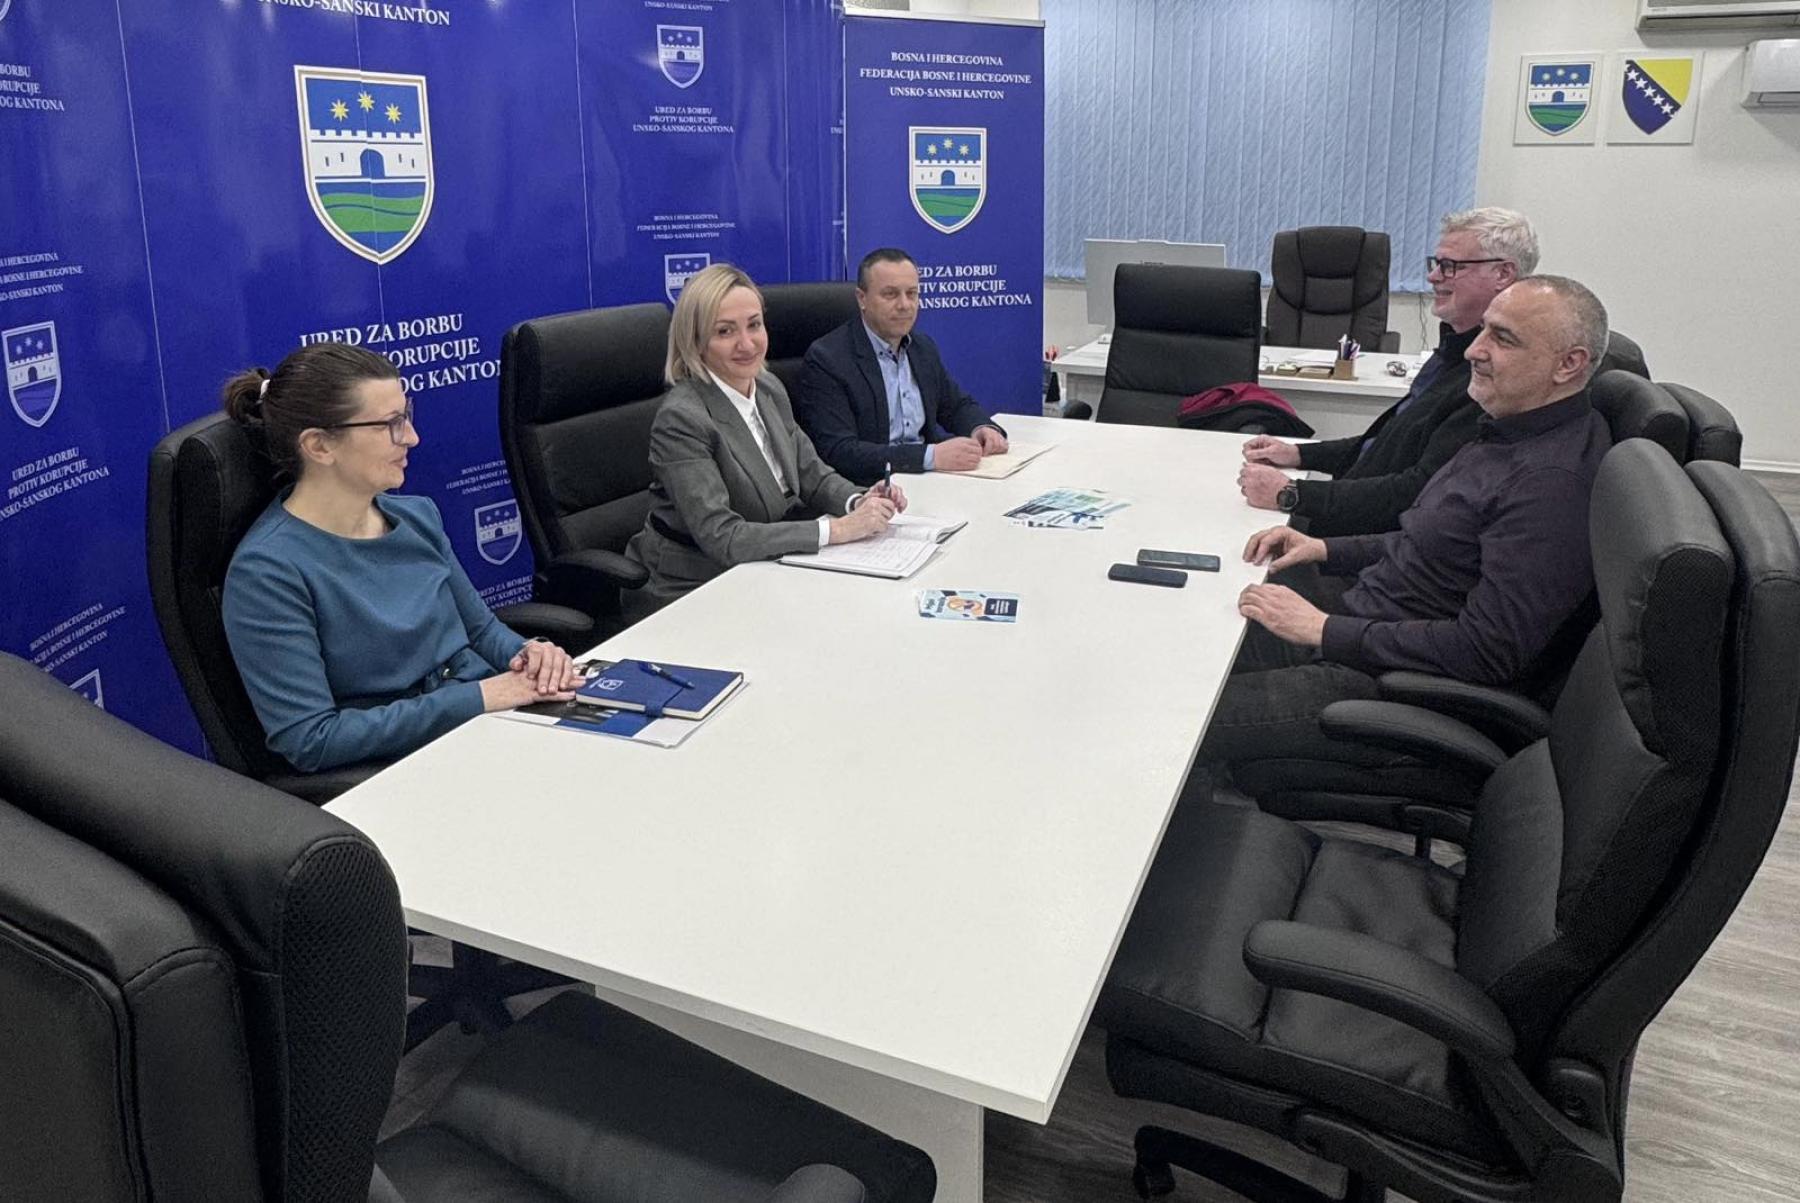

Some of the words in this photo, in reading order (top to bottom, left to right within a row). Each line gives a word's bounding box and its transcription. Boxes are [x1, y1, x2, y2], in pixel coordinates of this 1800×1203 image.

[384, 4, 450, 26] KANTON
[891, 51, 925, 62] BOSNA
[926, 53, 930, 62] I
[932, 53, 1003, 66] HERCEGOVINA
[860, 68, 920, 81] FEDERACIJA
[923, 70, 955, 80] BOSNE
[957, 71, 961, 80] I
[962, 72, 1031, 84] HERCEGOVINE
[890, 87, 962, 98] UNSKO-SANSKI
[963, 89, 1004, 100] KANTON
[15, 97, 65, 112] KANTONA
[677, 106, 686, 114] ZA
[935, 265, 953, 278] ZA
[955, 264, 998, 277] BORBU
[939, 279, 1007, 293] KORUPCIJE
[971, 294, 1033, 308] KANTONA
[367, 324, 395, 343] ZA
[400, 314, 463, 340] BORBU
[379, 338, 481, 369] ORUPCIJE
[12, 463, 35, 481] URED
[36, 458, 48, 472] ZA
[48, 447, 80, 467] BORBU
[8, 476, 39, 499] PROTIV
[39, 459, 89, 485] KORUPCIJE
[63, 466, 110, 490] KANTONA
